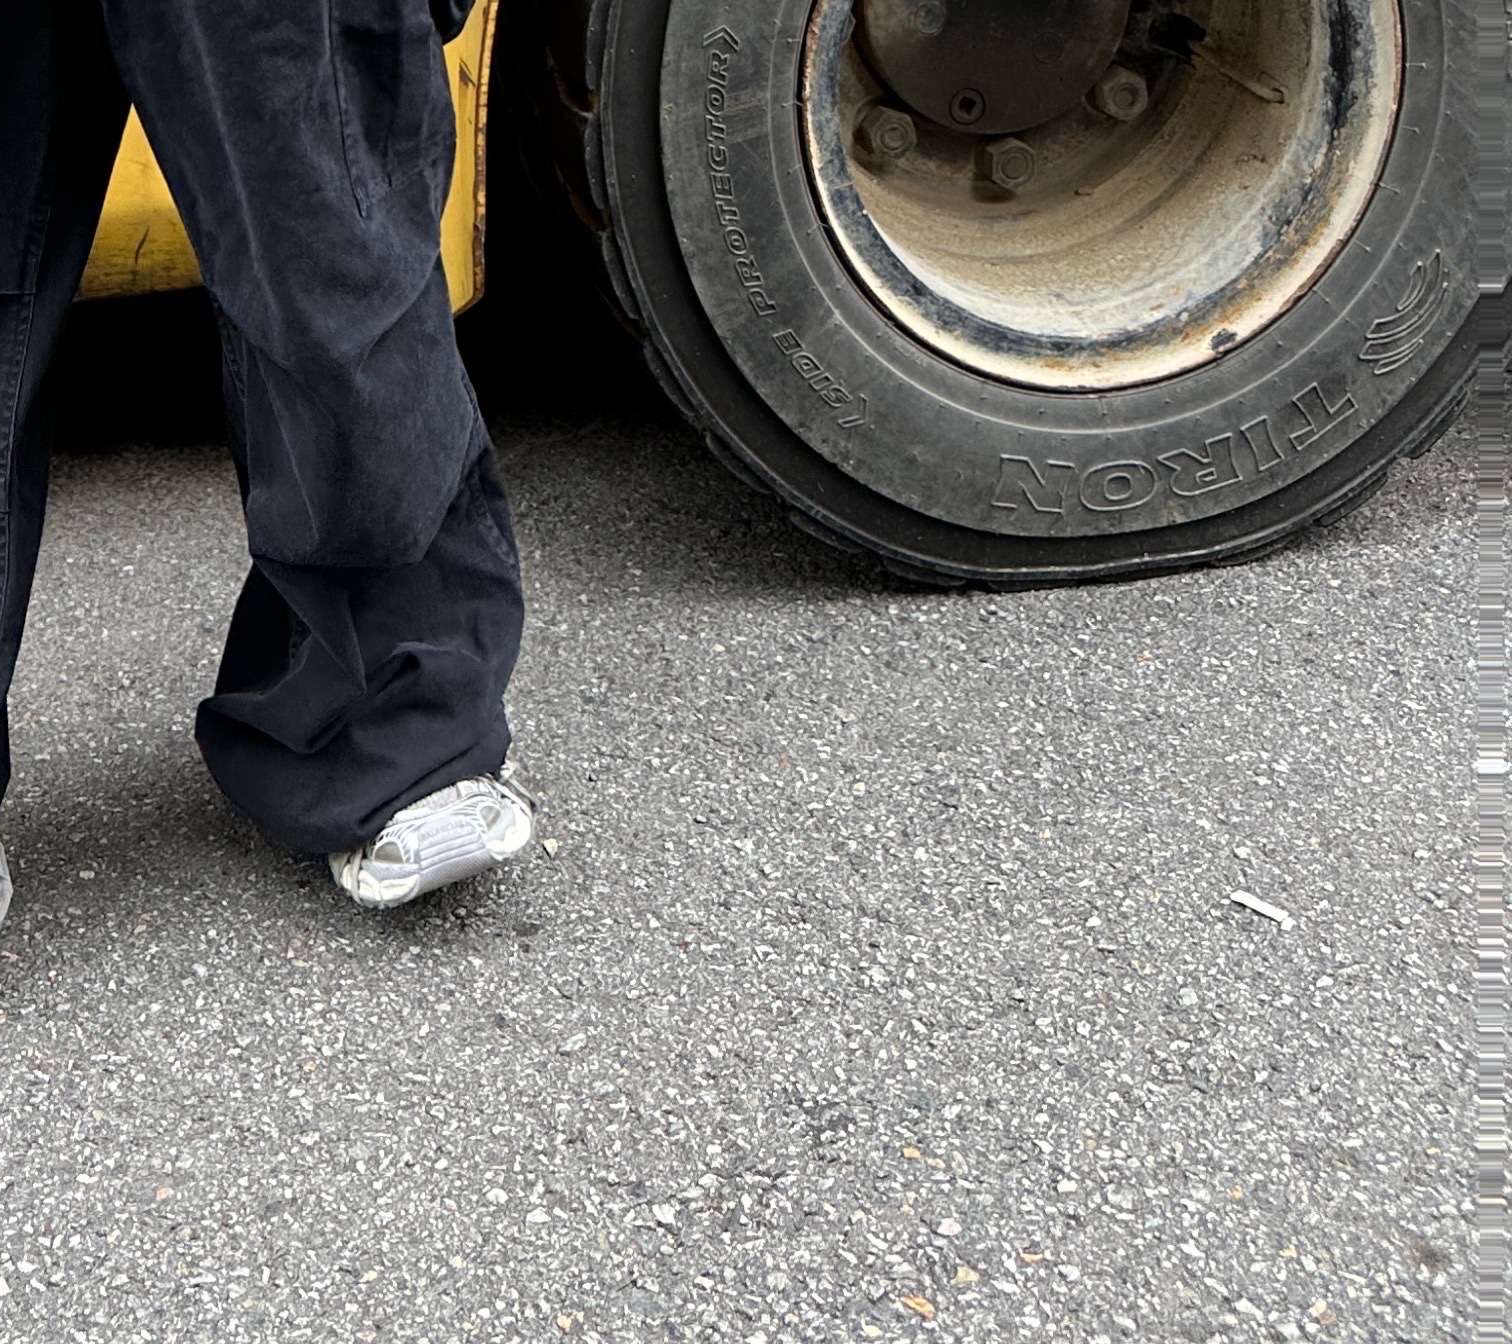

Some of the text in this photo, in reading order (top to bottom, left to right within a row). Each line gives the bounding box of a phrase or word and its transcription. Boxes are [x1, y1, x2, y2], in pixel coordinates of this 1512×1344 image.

[706, 49, 852, 408] SIDE PROTECTOR
[990, 381, 1359, 514] TIRON
